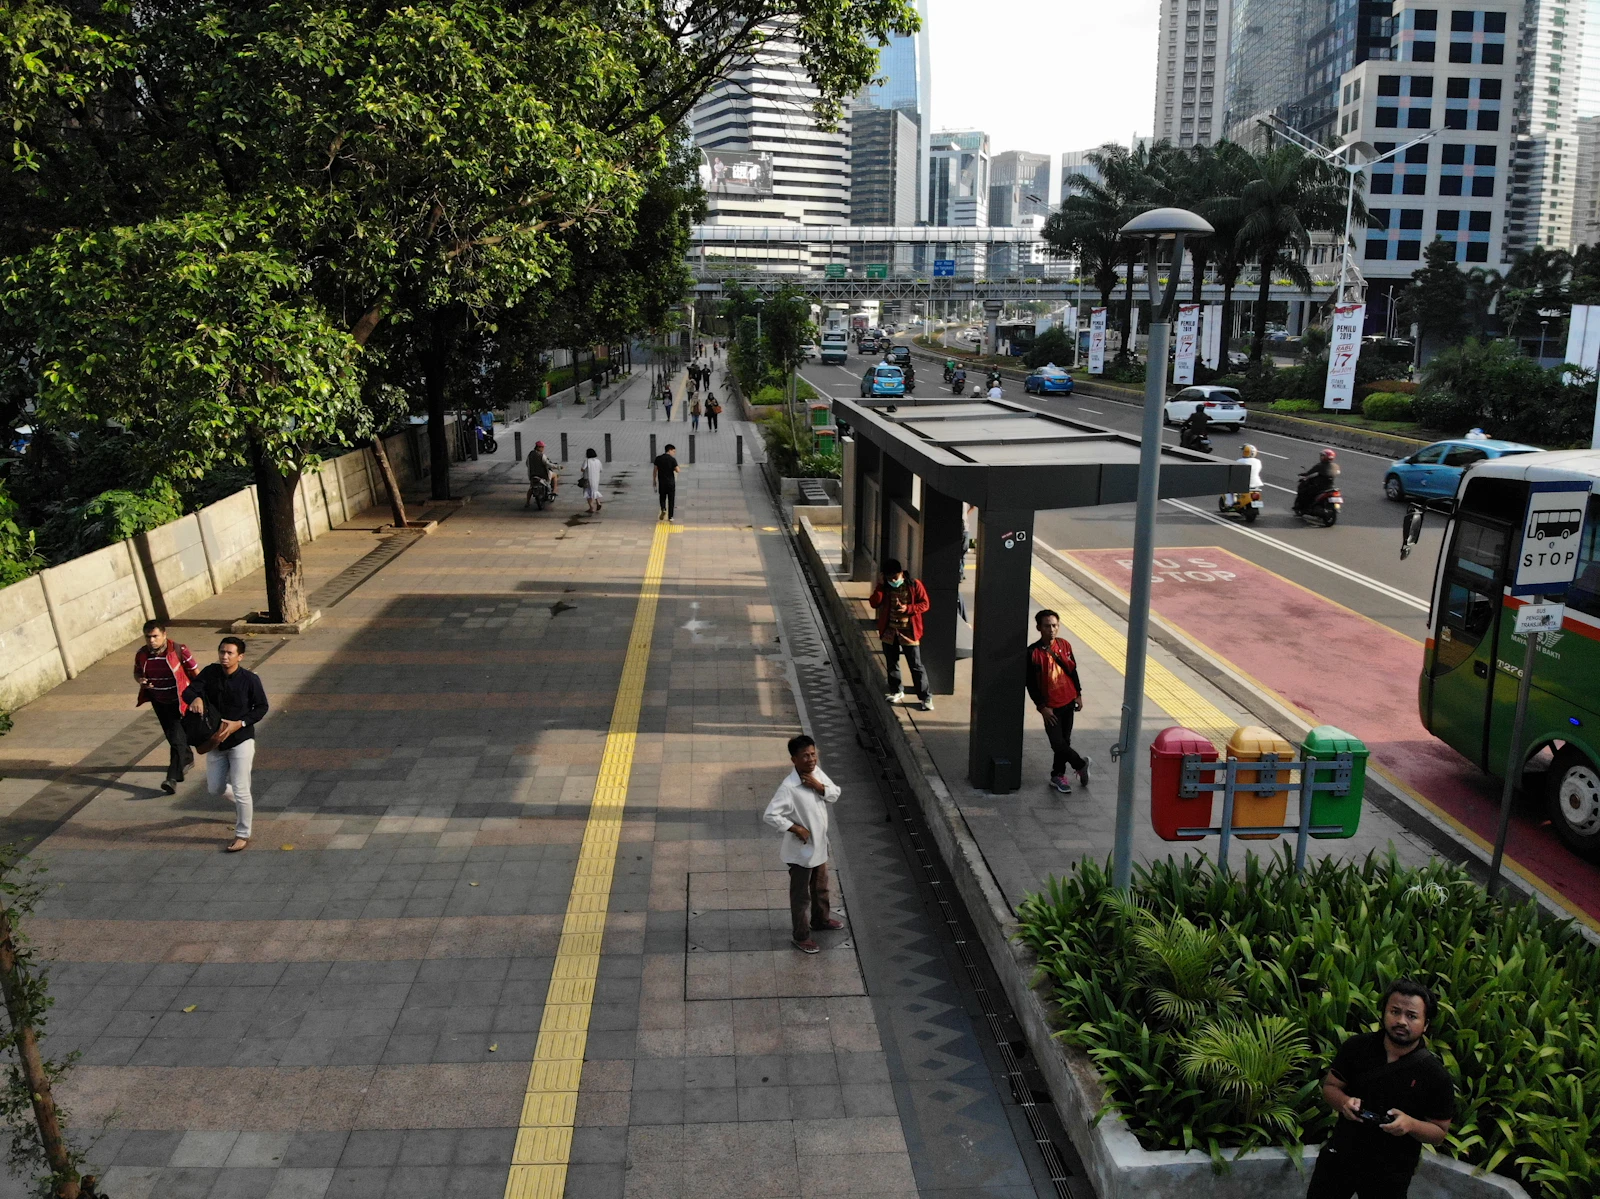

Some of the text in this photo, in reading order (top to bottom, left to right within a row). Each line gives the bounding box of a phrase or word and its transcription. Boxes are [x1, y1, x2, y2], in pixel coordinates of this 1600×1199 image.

[1179, 341, 1194, 353] 17
[1334, 353, 1353, 367] 17
[1523, 552, 1574, 567] STOP
[1542, 647, 1561, 660] BAKTI
